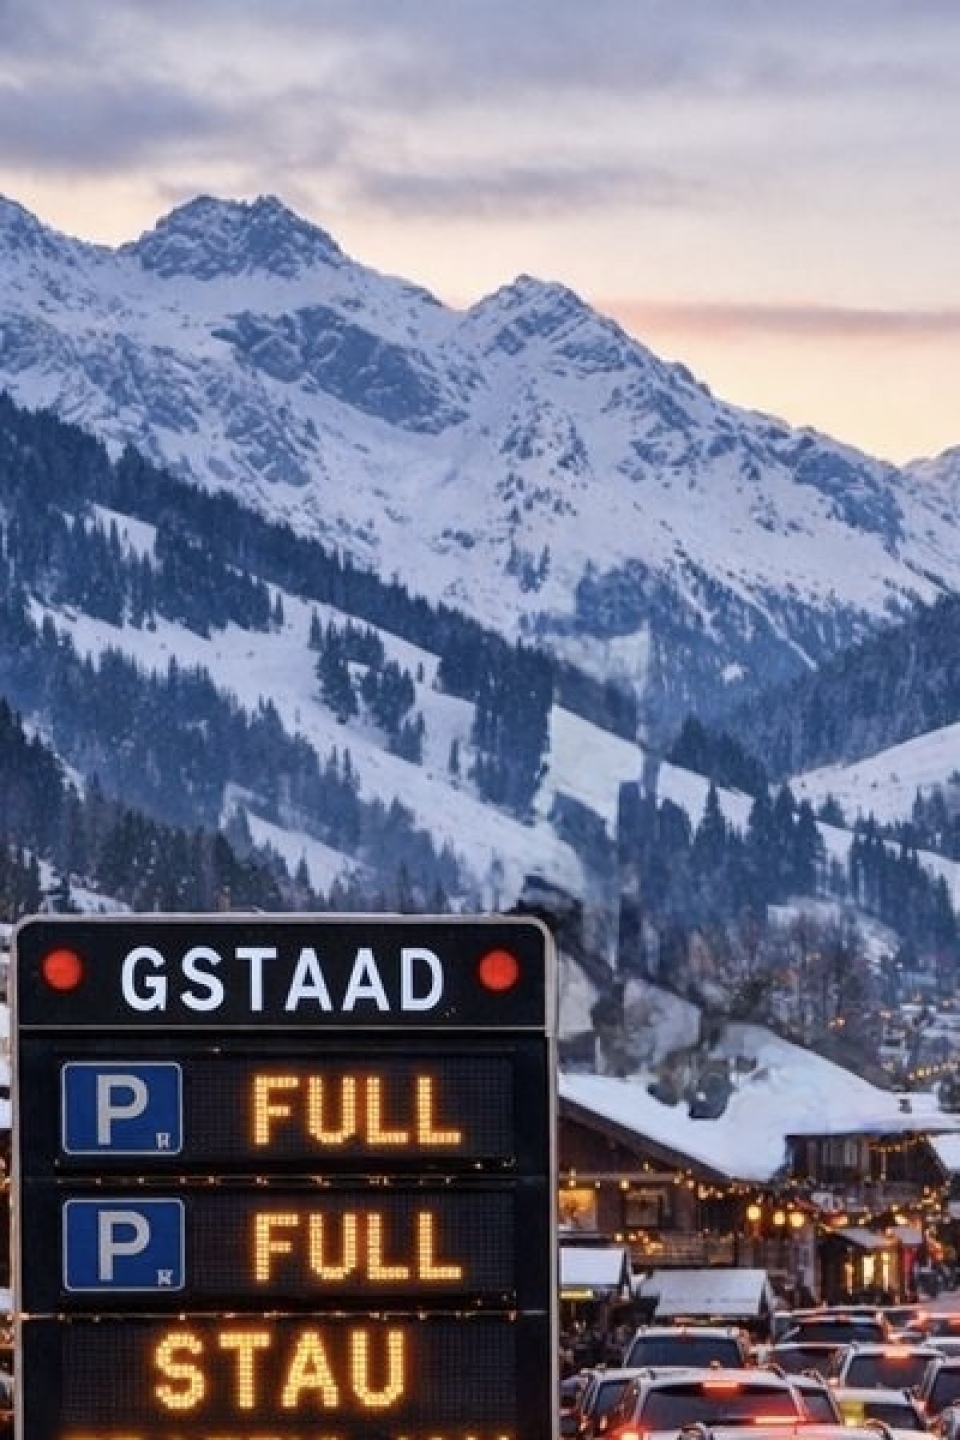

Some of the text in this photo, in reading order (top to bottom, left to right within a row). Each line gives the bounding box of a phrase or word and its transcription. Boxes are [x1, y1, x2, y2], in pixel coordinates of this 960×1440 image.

[121, 947, 444, 1011] GSTAAD
[97, 1074, 149, 1145] P
[253, 1076, 462, 1145] FULL
[98, 1209, 151, 1281] P
[254, 1212, 463, 1281] FULL
[154, 1330, 406, 1410] STAU
